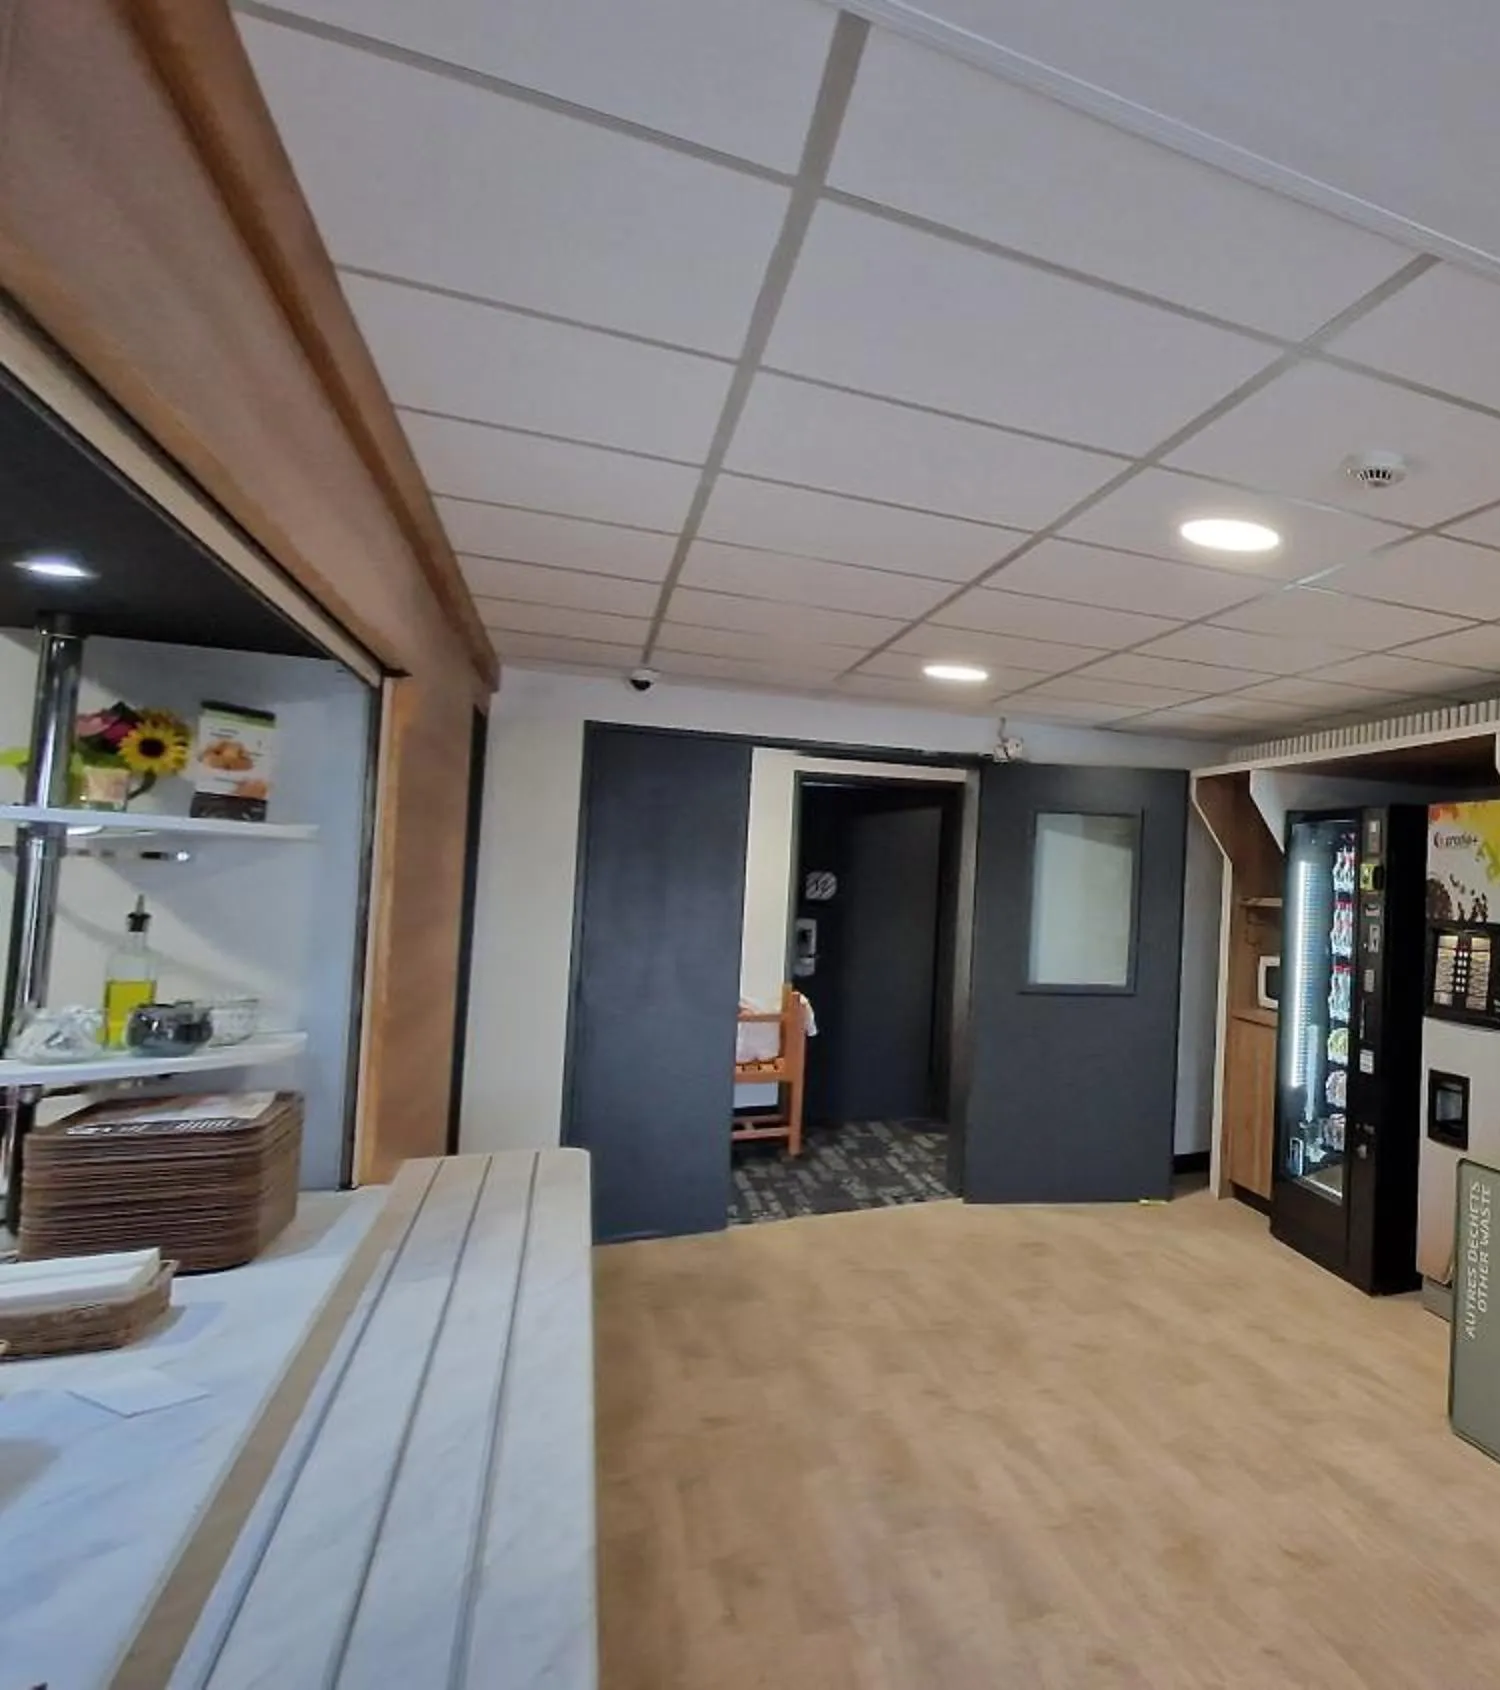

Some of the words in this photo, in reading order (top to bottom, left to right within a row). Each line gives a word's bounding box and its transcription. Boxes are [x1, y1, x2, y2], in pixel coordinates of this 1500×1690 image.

[1480, 1183, 1492, 1247] WASTE
[1465, 1266, 1478, 1339] AUTRES
[1477, 1252, 1490, 1313] OTHER
